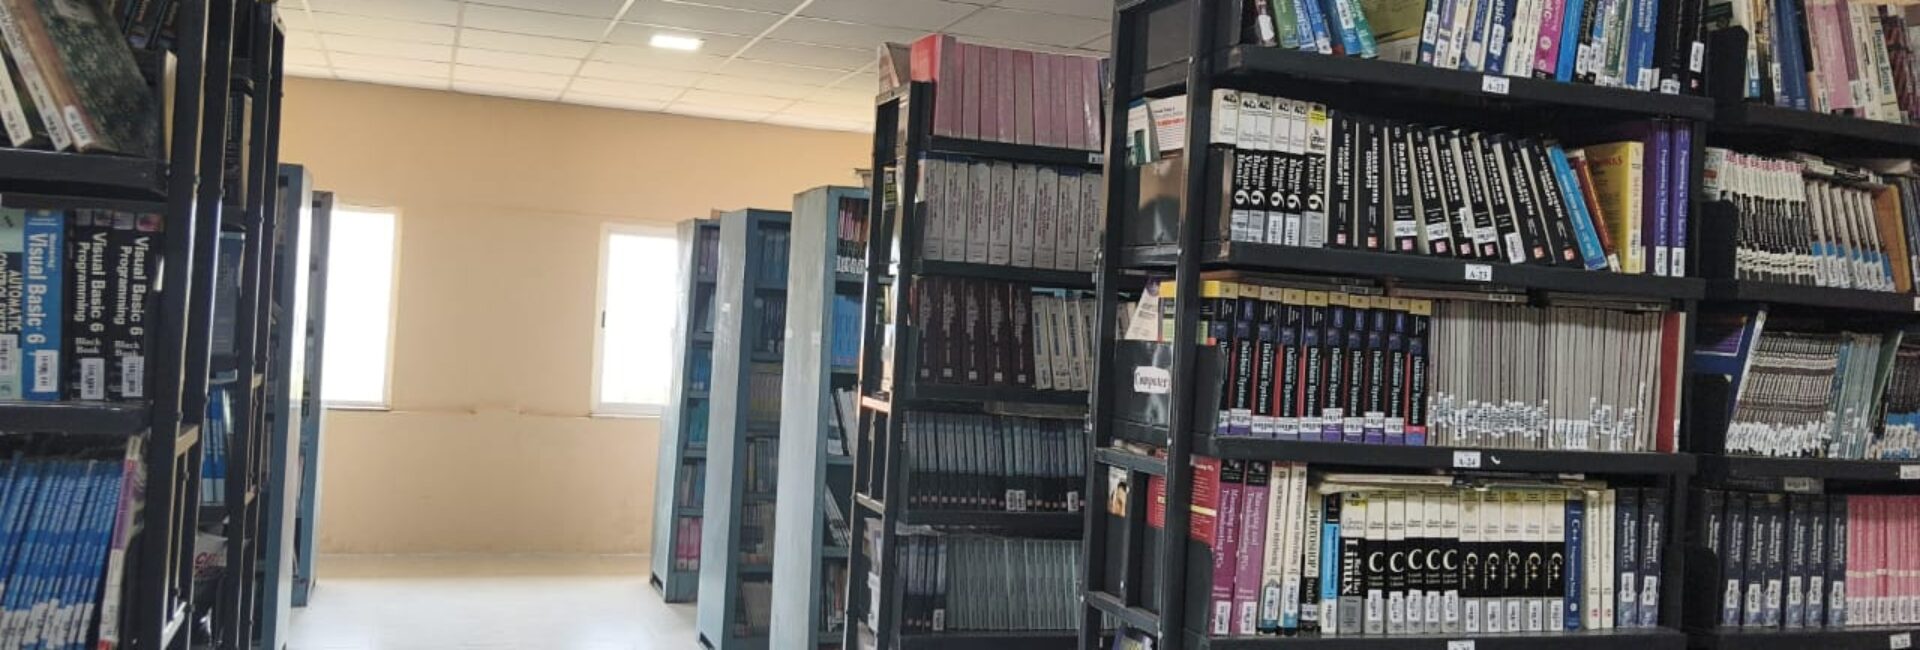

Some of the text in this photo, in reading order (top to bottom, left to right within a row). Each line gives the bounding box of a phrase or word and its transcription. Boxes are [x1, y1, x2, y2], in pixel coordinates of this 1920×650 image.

[1234, 190, 1250, 205] 6
[1251, 190, 1266, 205] 6
[1270, 192, 1285, 208] 6
[1286, 194, 1301, 210] 6
[1307, 194, 1324, 211] 6
[27, 232, 49, 280] Visual
[74, 241, 91, 323] Programming
[90, 232, 107, 333] Visual Basic 6
[113, 245, 133, 325] Programming
[129, 236, 150, 336] Visual Basic 6
[8, 270, 23, 332] AUTOMATIC
[27, 283, 48, 327] Basic
[27, 332, 47, 345] 6
[1308, 509, 1319, 568] PHOTOSHOP
[1571, 518, 1581, 541] C++
[1342, 538, 1359, 596] Linux
[1368, 551, 1384, 573] C
[1389, 551, 1404, 573] C
[1408, 548, 1423, 570] C
[1426, 548, 1441, 570] C
[1442, 548, 1458, 570] C
[1466, 552, 1478, 579] C++
[1488, 552, 1500, 579] C++
[1509, 552, 1520, 579] C++
[1529, 552, 1541, 579] C++
[1551, 552, 1563, 579] C++
